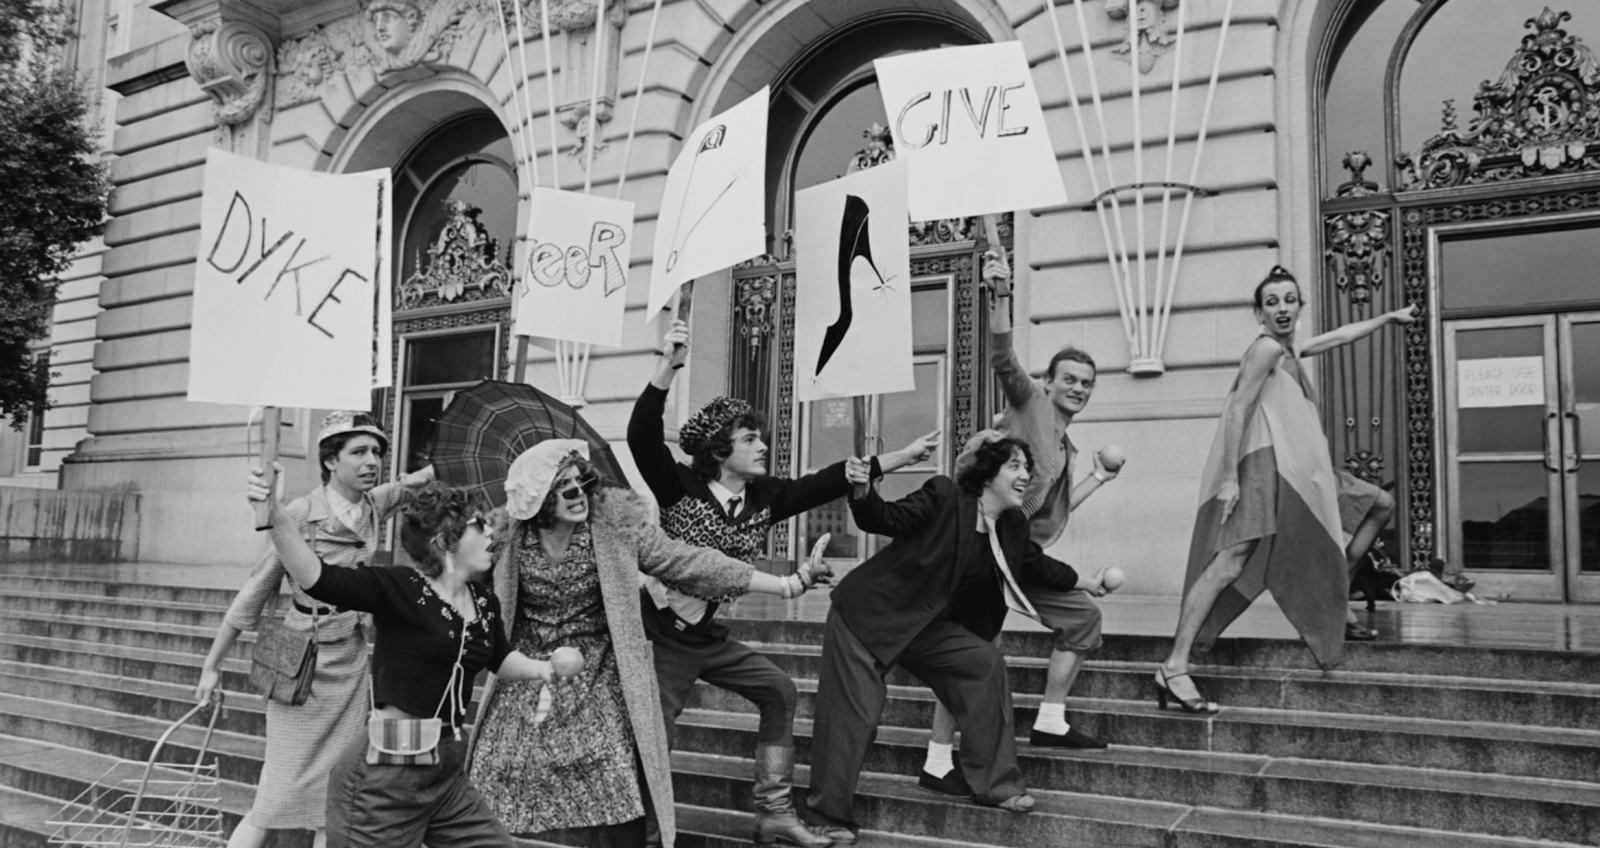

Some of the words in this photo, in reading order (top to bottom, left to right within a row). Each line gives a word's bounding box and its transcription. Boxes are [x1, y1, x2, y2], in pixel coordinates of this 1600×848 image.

[896, 81, 1029, 149] GIVE
[207, 190, 368, 339] DYKE
[1464, 367, 1504, 382] PLEASE
[1511, 365, 1535, 379] USE
[1465, 384, 1503, 398] CENTER
[1509, 383, 1537, 396] DOOR
